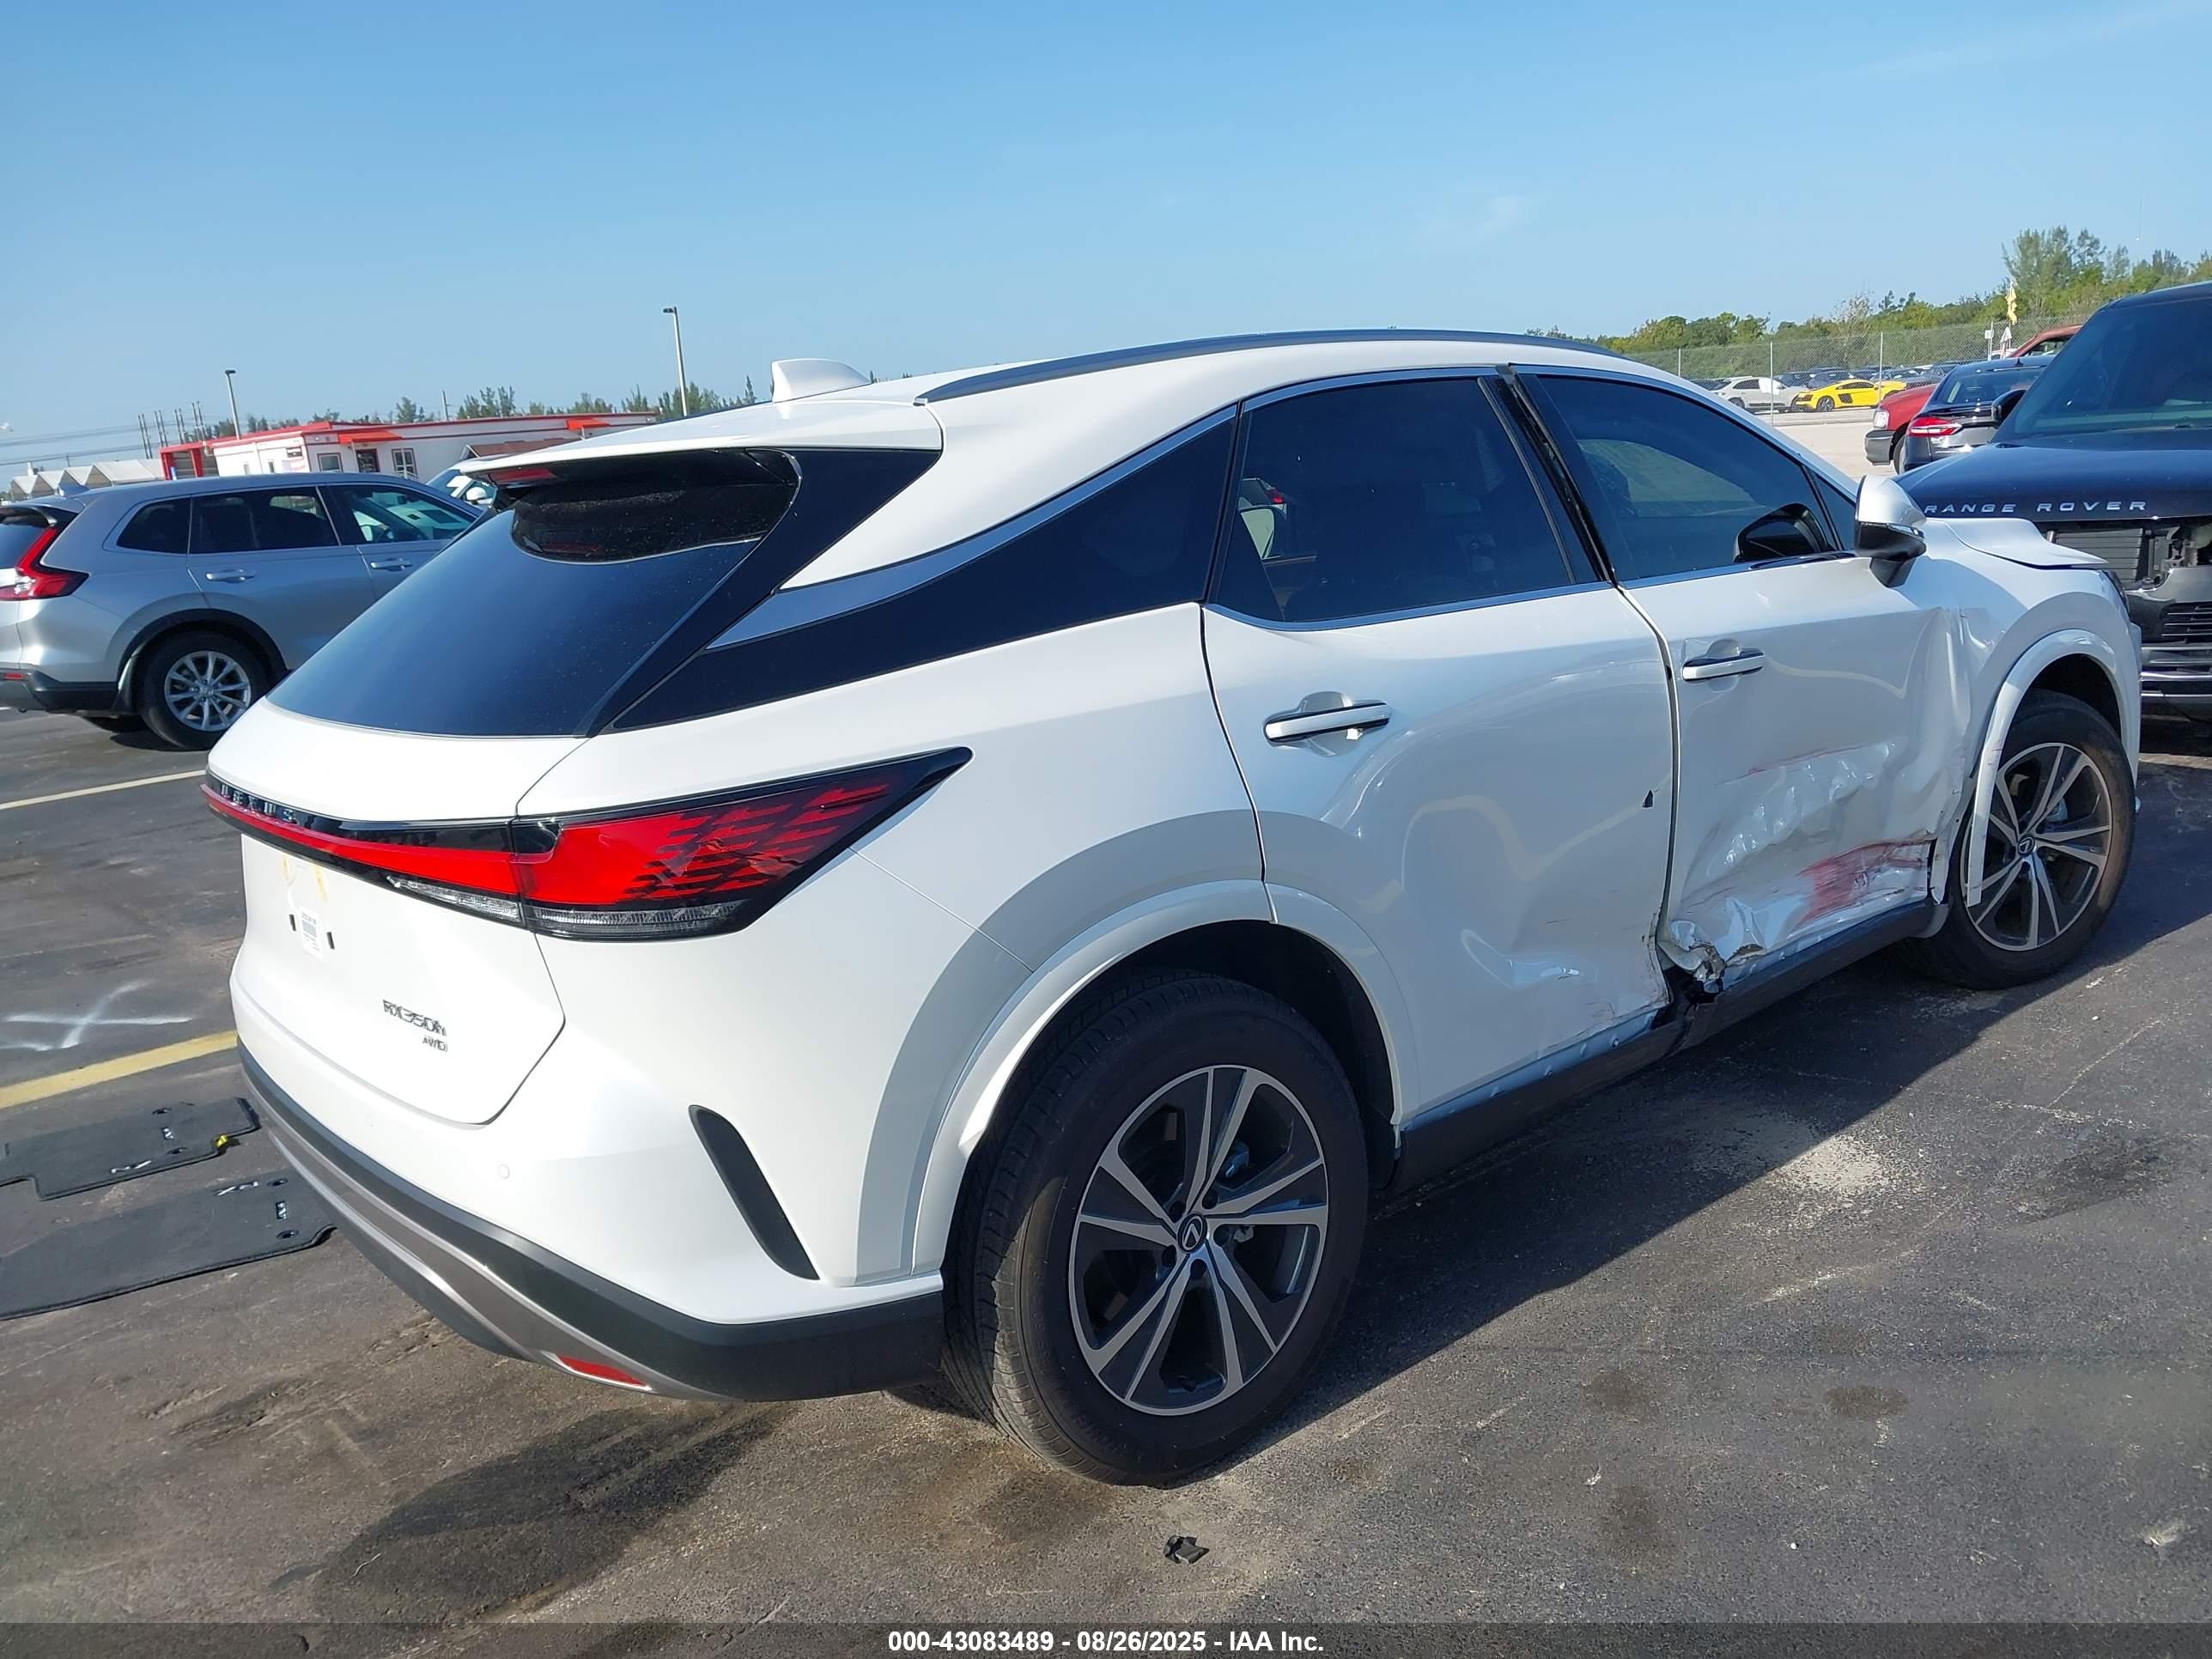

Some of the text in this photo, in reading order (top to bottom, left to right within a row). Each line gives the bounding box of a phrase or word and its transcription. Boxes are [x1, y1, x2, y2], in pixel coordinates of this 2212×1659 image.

[1923, 501, 2148, 514] RANGE ROVER
[422, 1035, 448, 1052] AWD
